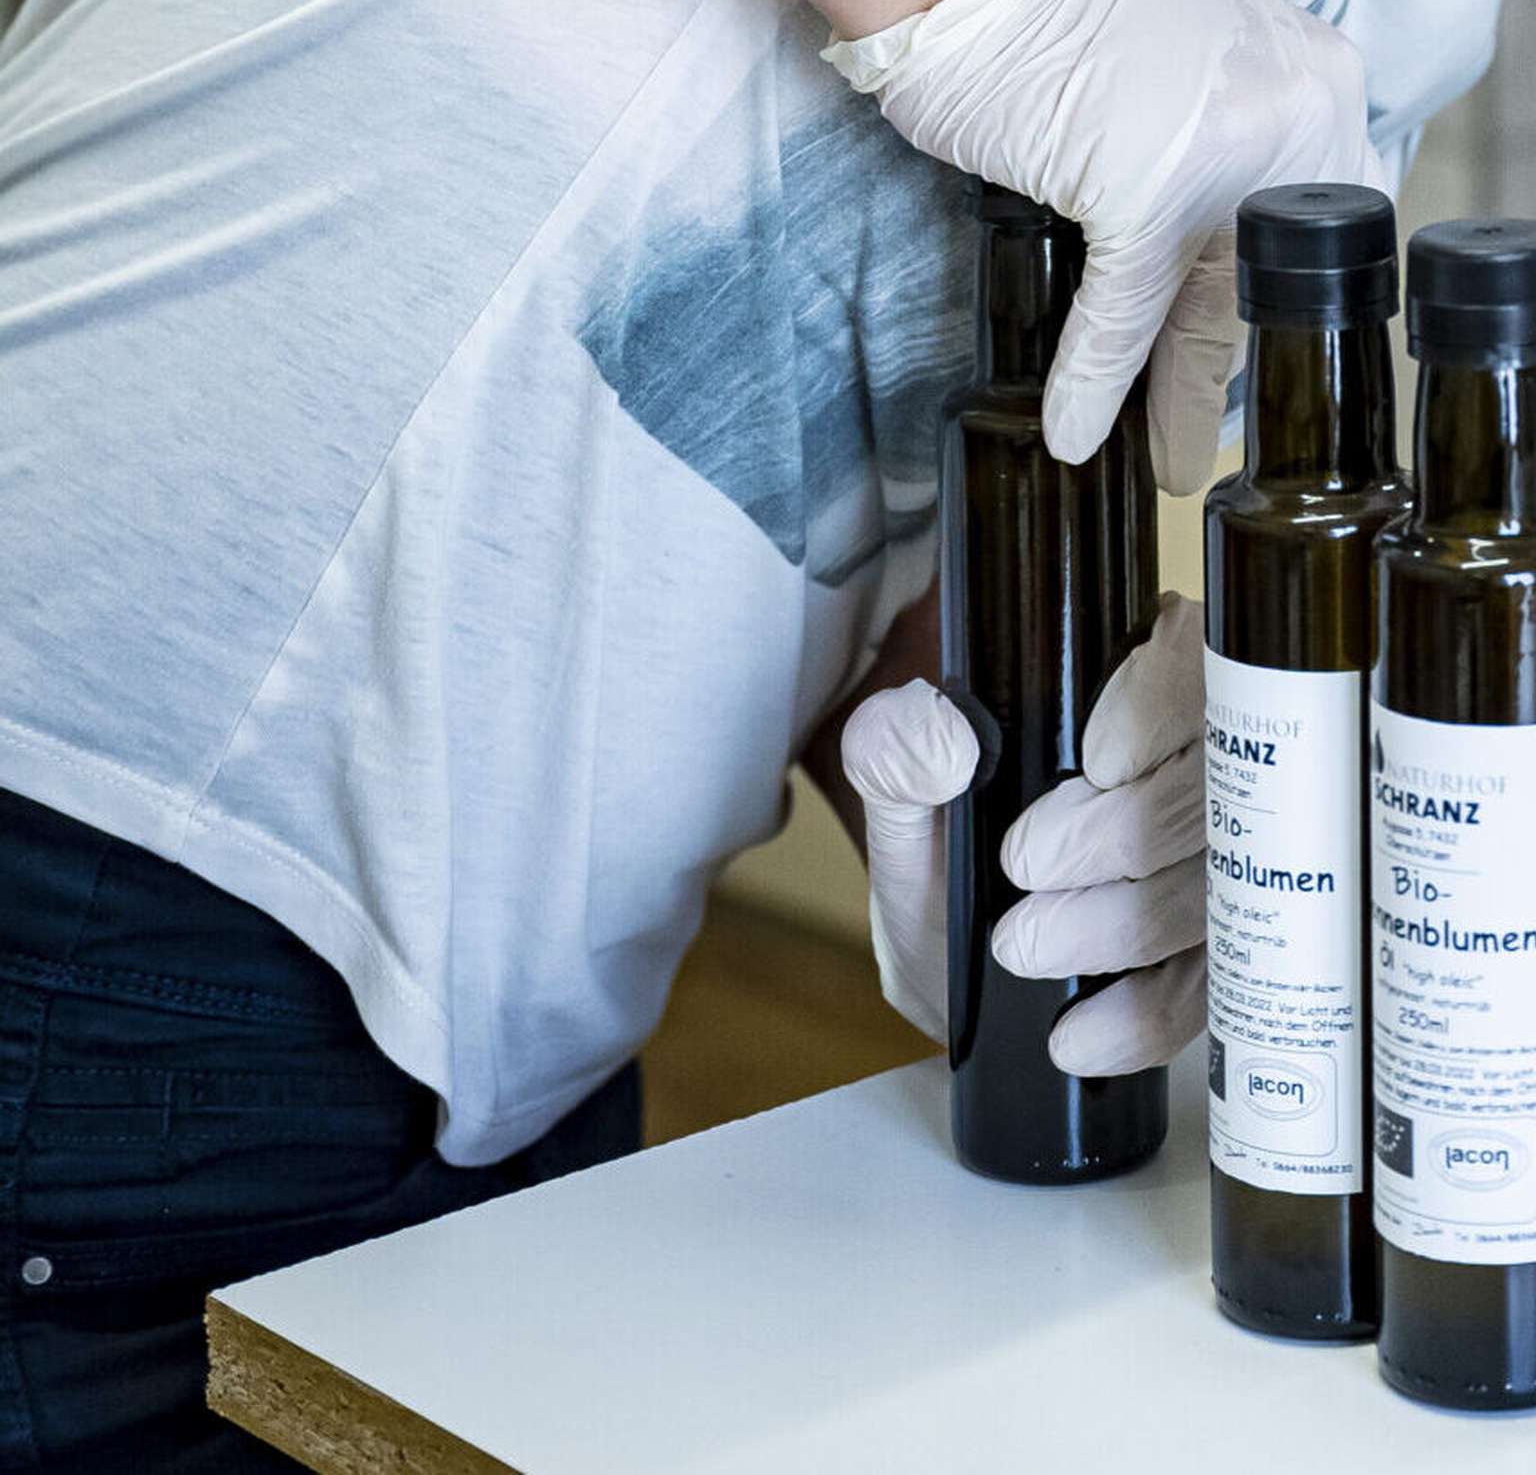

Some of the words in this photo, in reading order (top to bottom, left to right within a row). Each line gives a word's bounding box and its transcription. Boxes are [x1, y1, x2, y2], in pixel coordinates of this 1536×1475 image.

[1206, 719, 1277, 766] CHRANZ
[1210, 799, 1252, 837] Bio-
[1207, 844, 1335, 893] enblumen
[1391, 865, 1453, 902] Bio-
